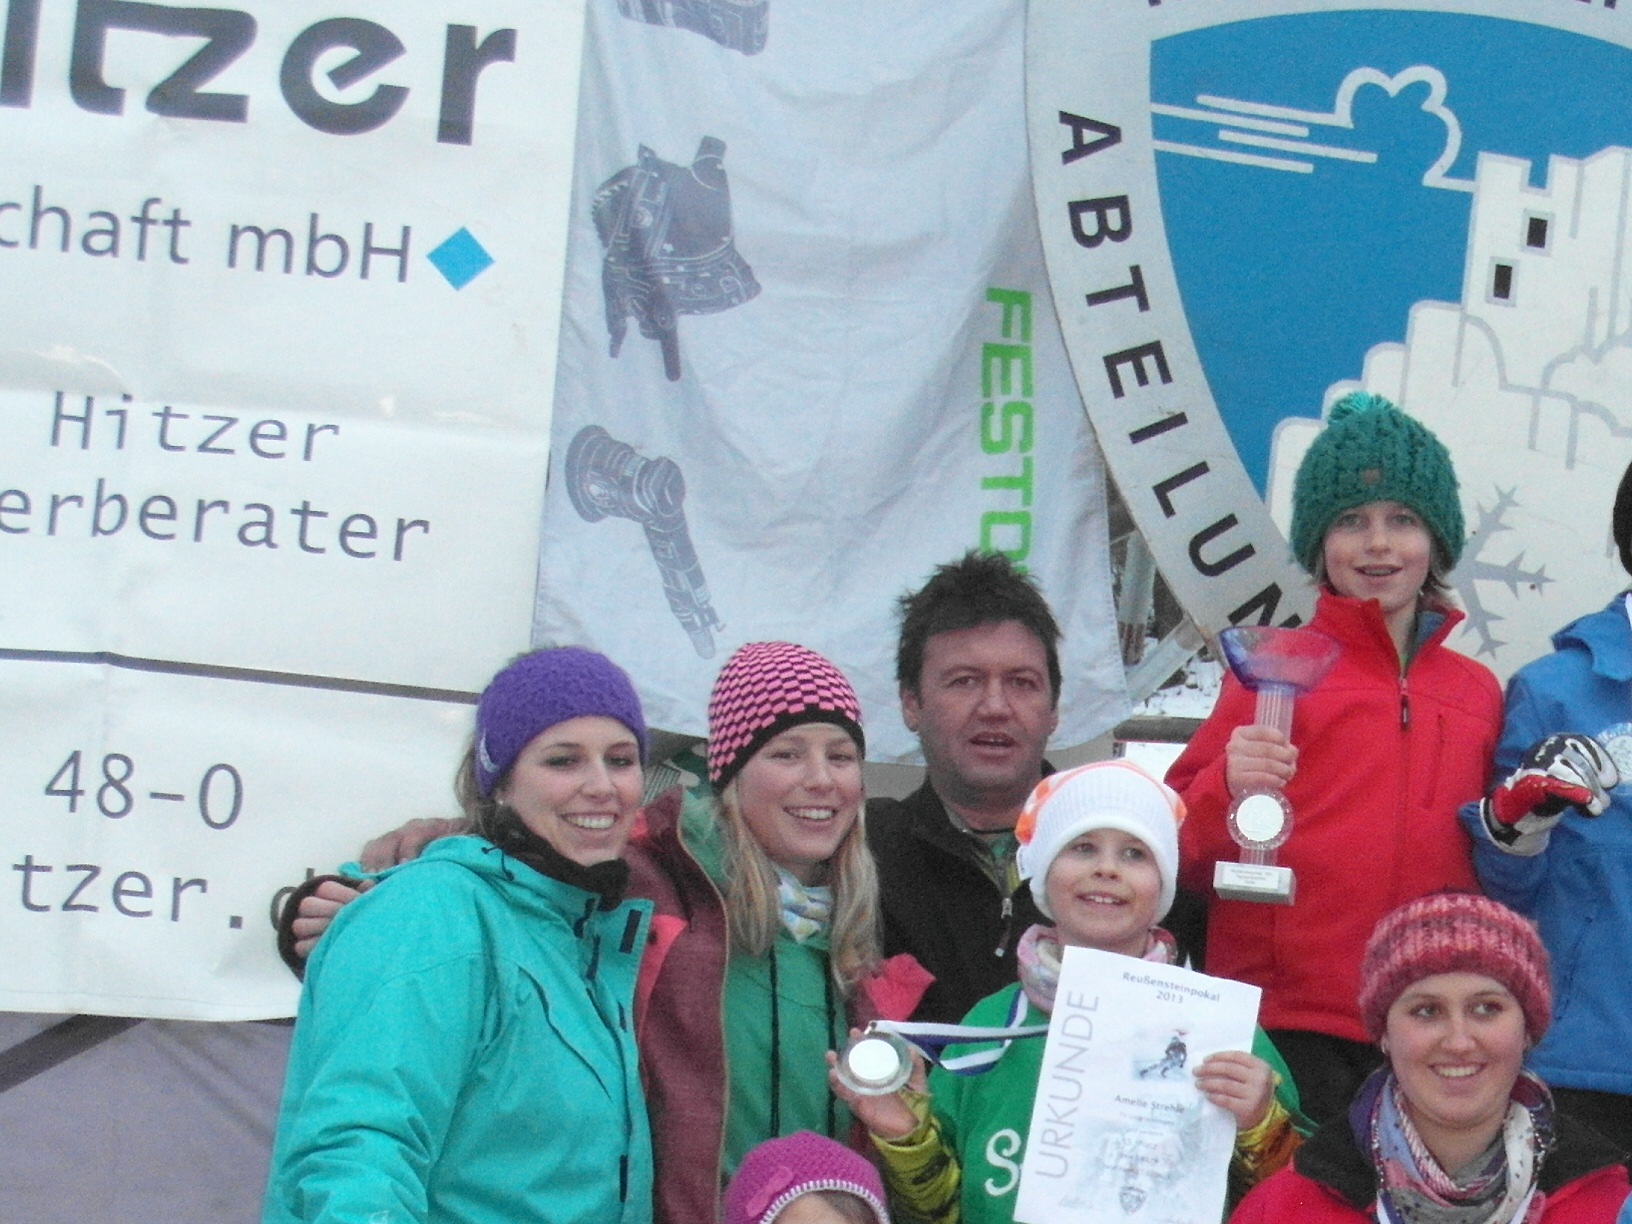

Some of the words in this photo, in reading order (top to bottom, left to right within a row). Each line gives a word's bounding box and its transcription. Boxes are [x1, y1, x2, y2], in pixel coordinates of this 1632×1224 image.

[227, 212, 412, 284] mbH
[1058, 110, 1303, 632] ABTEILUN
[49, 390, 341, 462] Hitzer
[979, 287, 1034, 574] FESTO
[0, 478, 431, 562] erberater
[45, 750, 244, 830] 48-0
[1122, 971, 1221, 1002] Reußensteinpokal
[1155, 990, 1185, 1005] 2013
[1035, 990, 1100, 1179] URKUNDE
